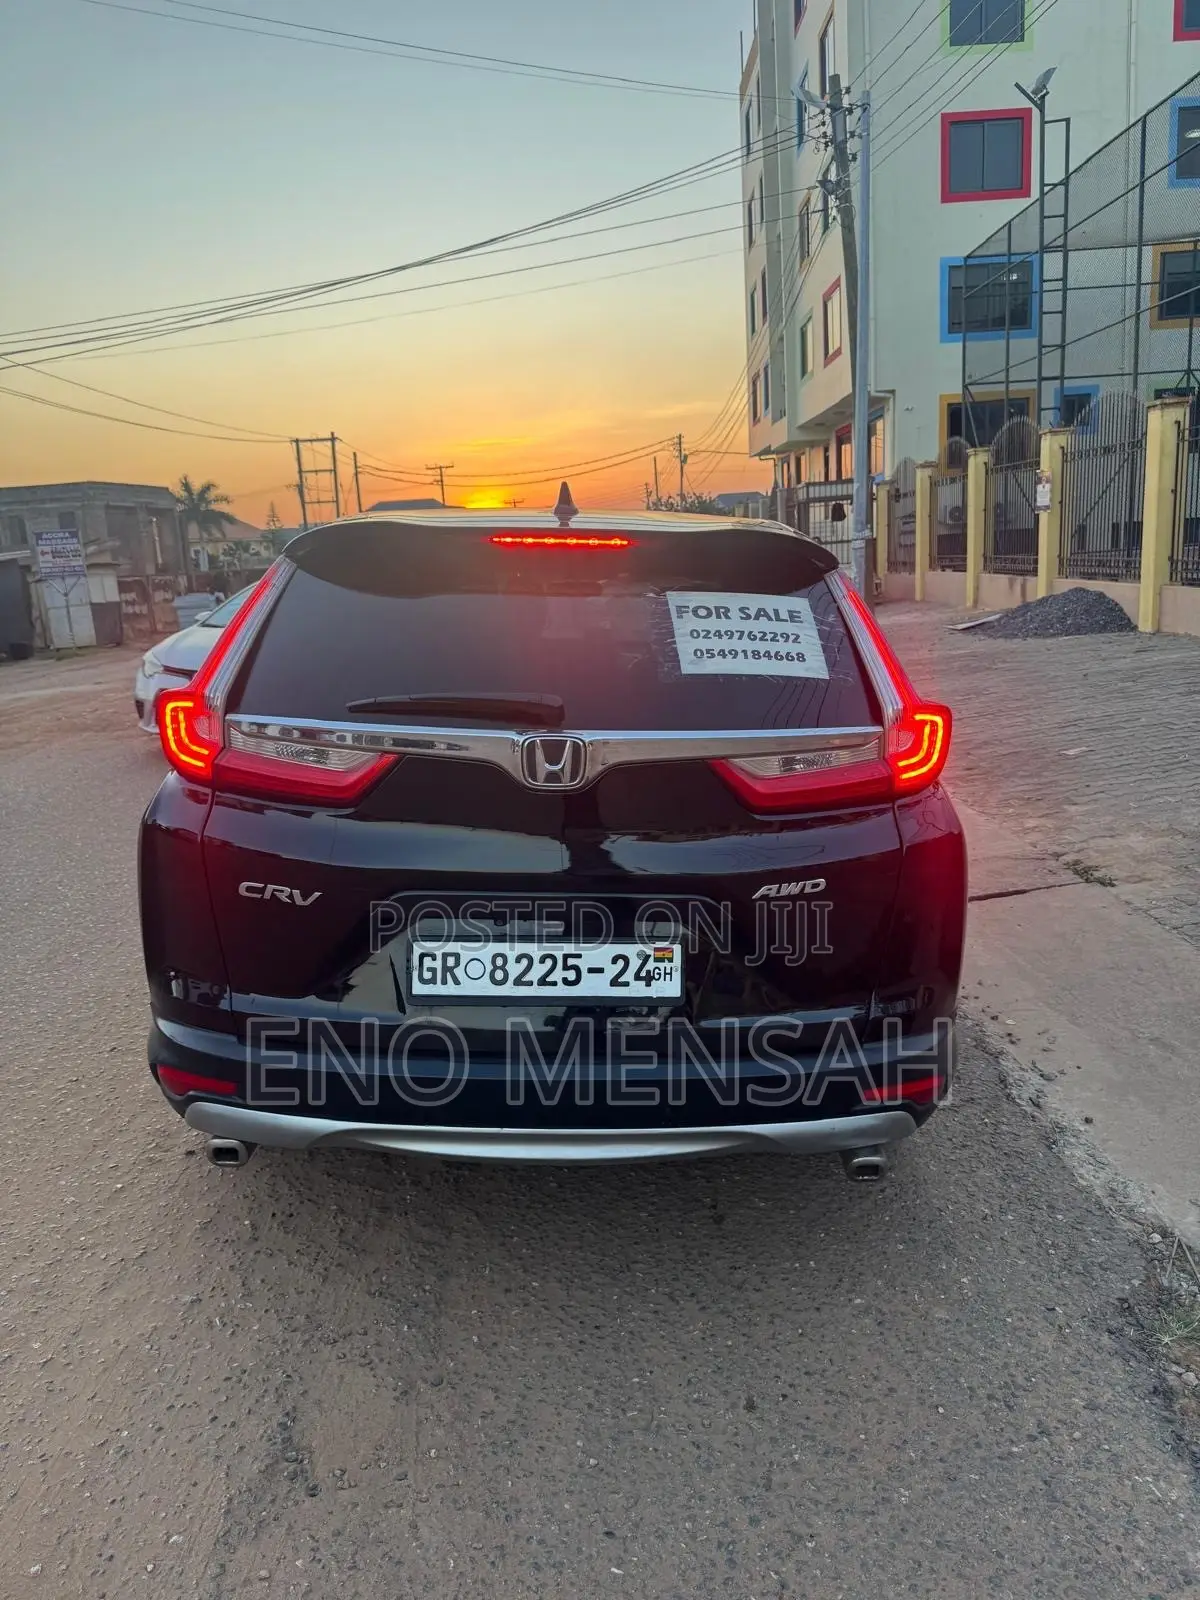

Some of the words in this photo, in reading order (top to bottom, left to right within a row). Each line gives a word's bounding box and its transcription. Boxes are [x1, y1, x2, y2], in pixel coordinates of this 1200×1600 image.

[675, 605, 732, 620] FOR
[738, 606, 804, 624] SALE
[689, 628, 802, 644] 0249762292
[693, 648, 807, 663] 0549184668
[238, 881, 323, 906] CRV
[751, 878, 827, 899] AWD
[417, 951, 461, 986] GR
[488, 952, 653, 988] 8225-24
[652, 966, 673, 982] GH
